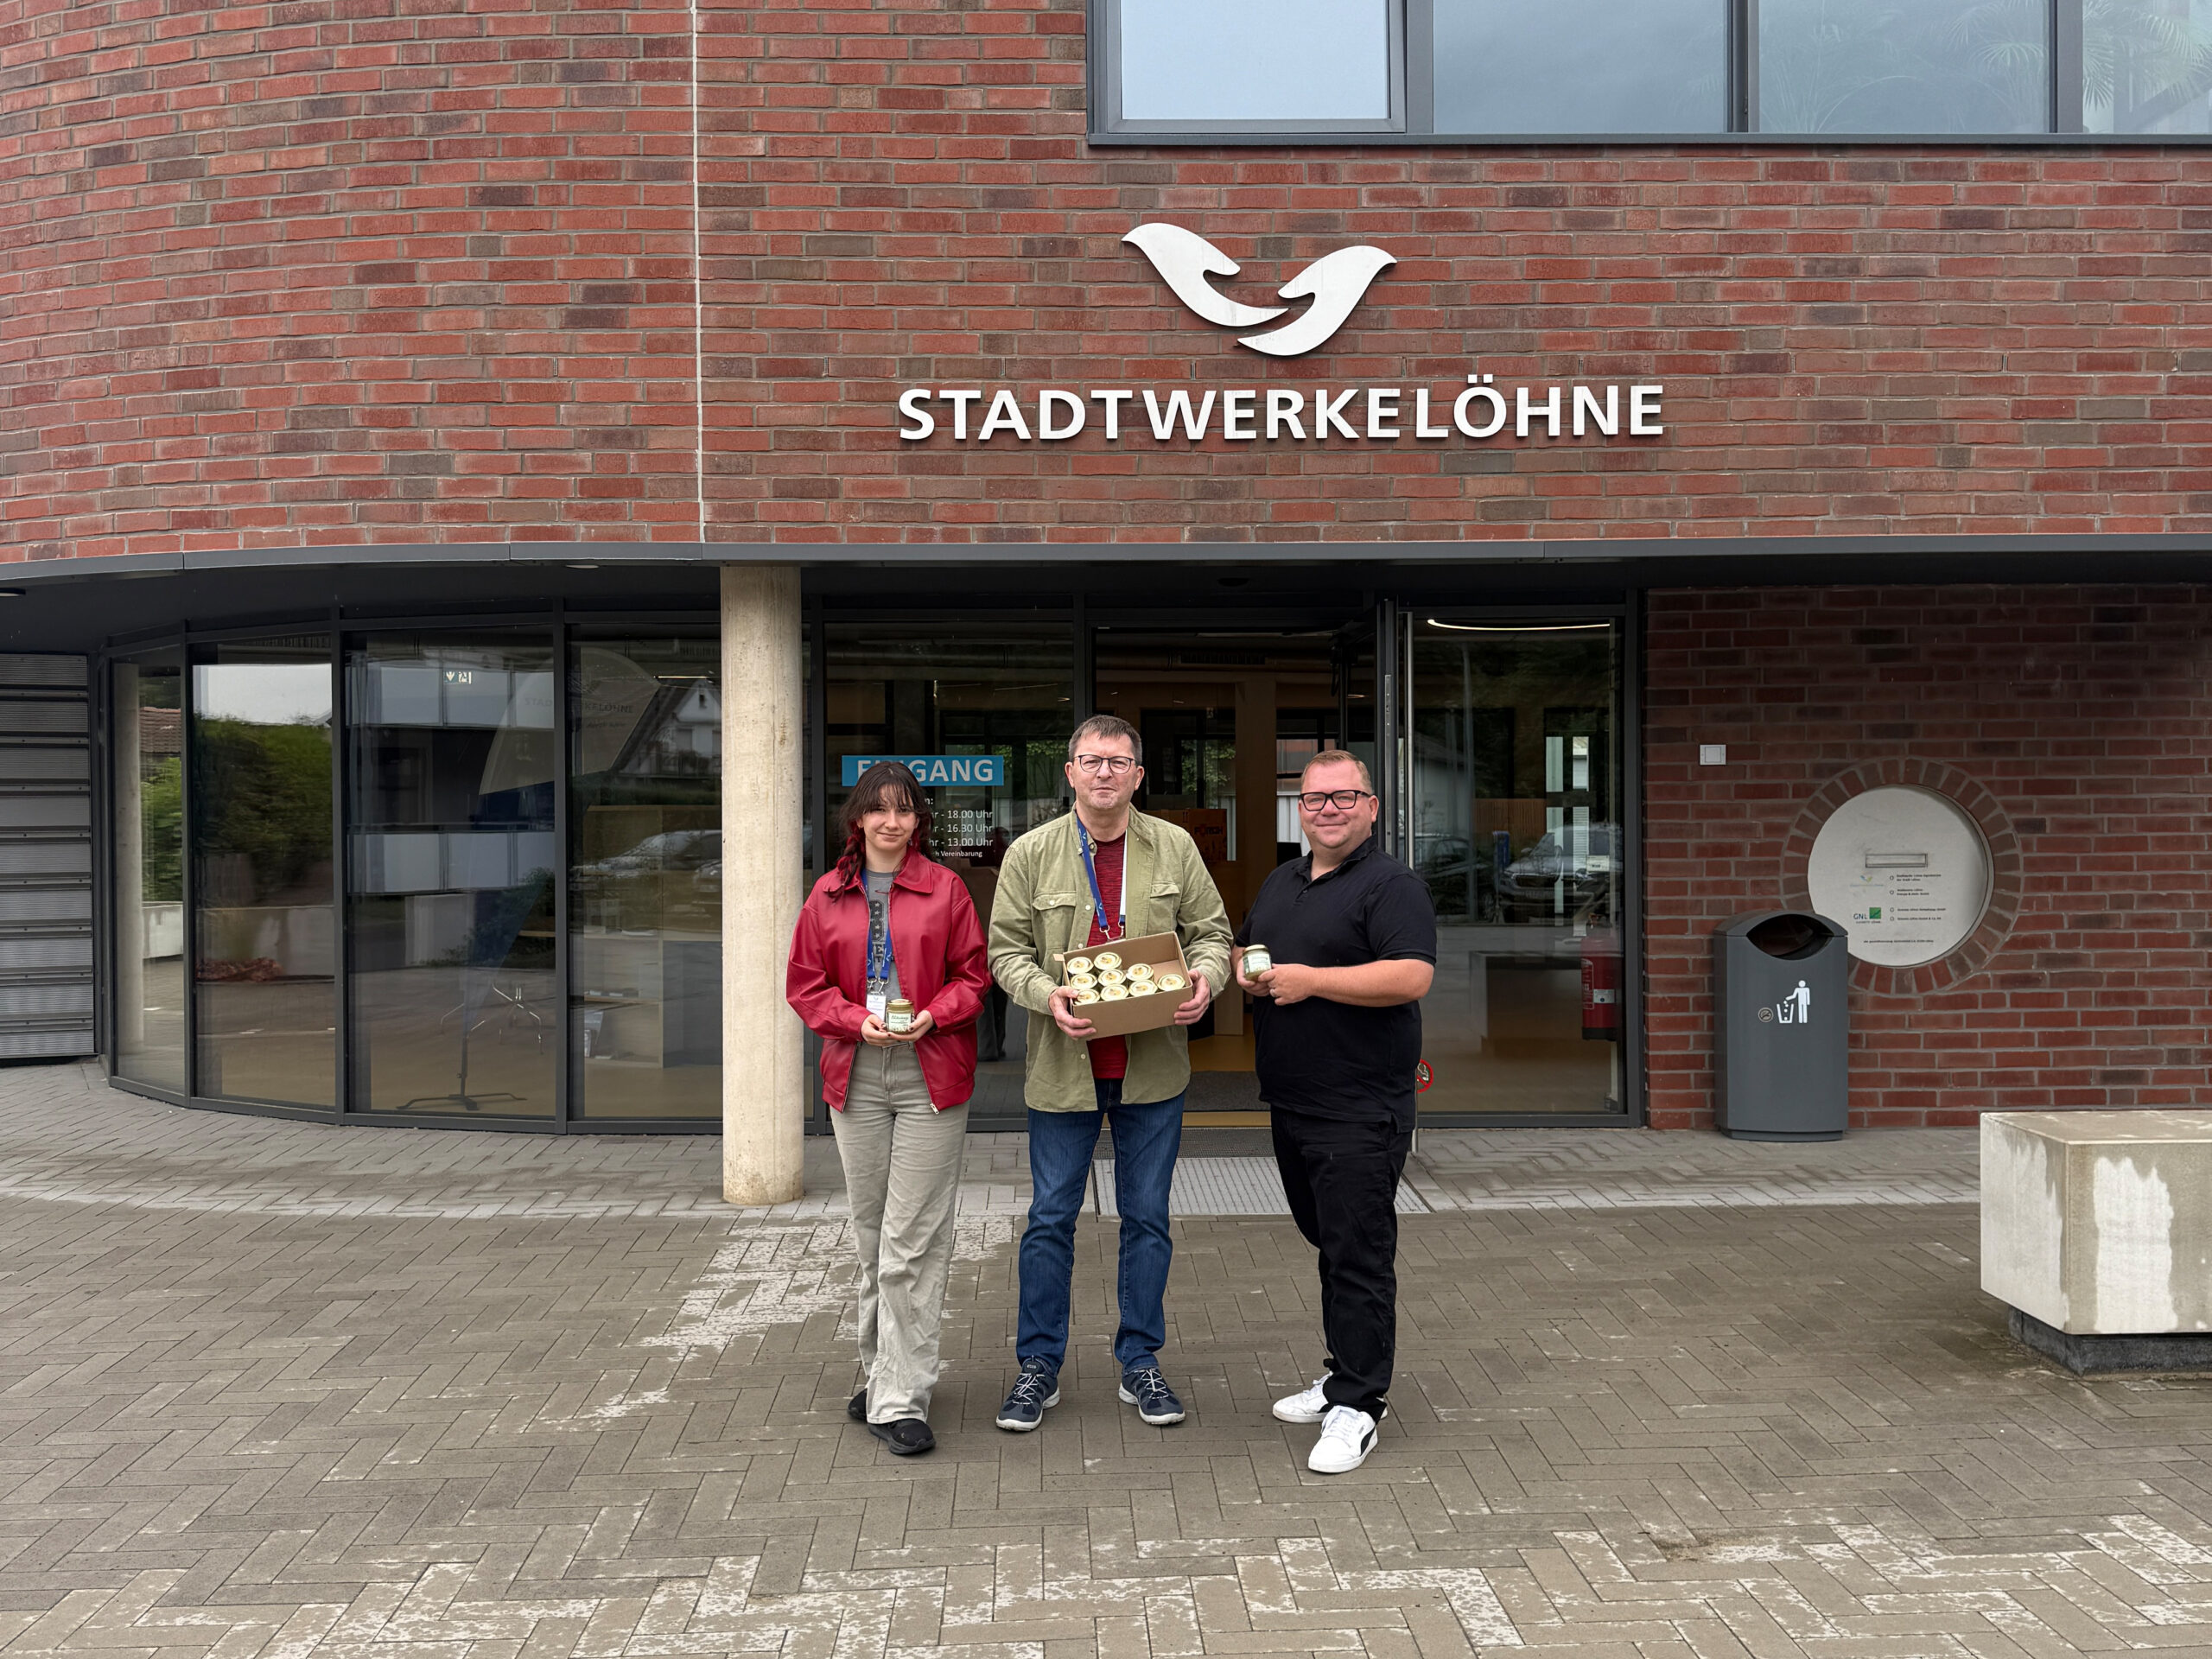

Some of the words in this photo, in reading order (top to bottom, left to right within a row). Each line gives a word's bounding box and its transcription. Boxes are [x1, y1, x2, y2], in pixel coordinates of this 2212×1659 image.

[857, 760, 995, 782] EGANG
[947, 810, 974, 819] 18.00
[976, 809, 993, 819] Uhr
[947, 823, 973, 833] 16.30
[976, 823, 993, 833] Uhr
[947, 837, 974, 847] 13.00
[976, 837, 994, 847] Uhr
